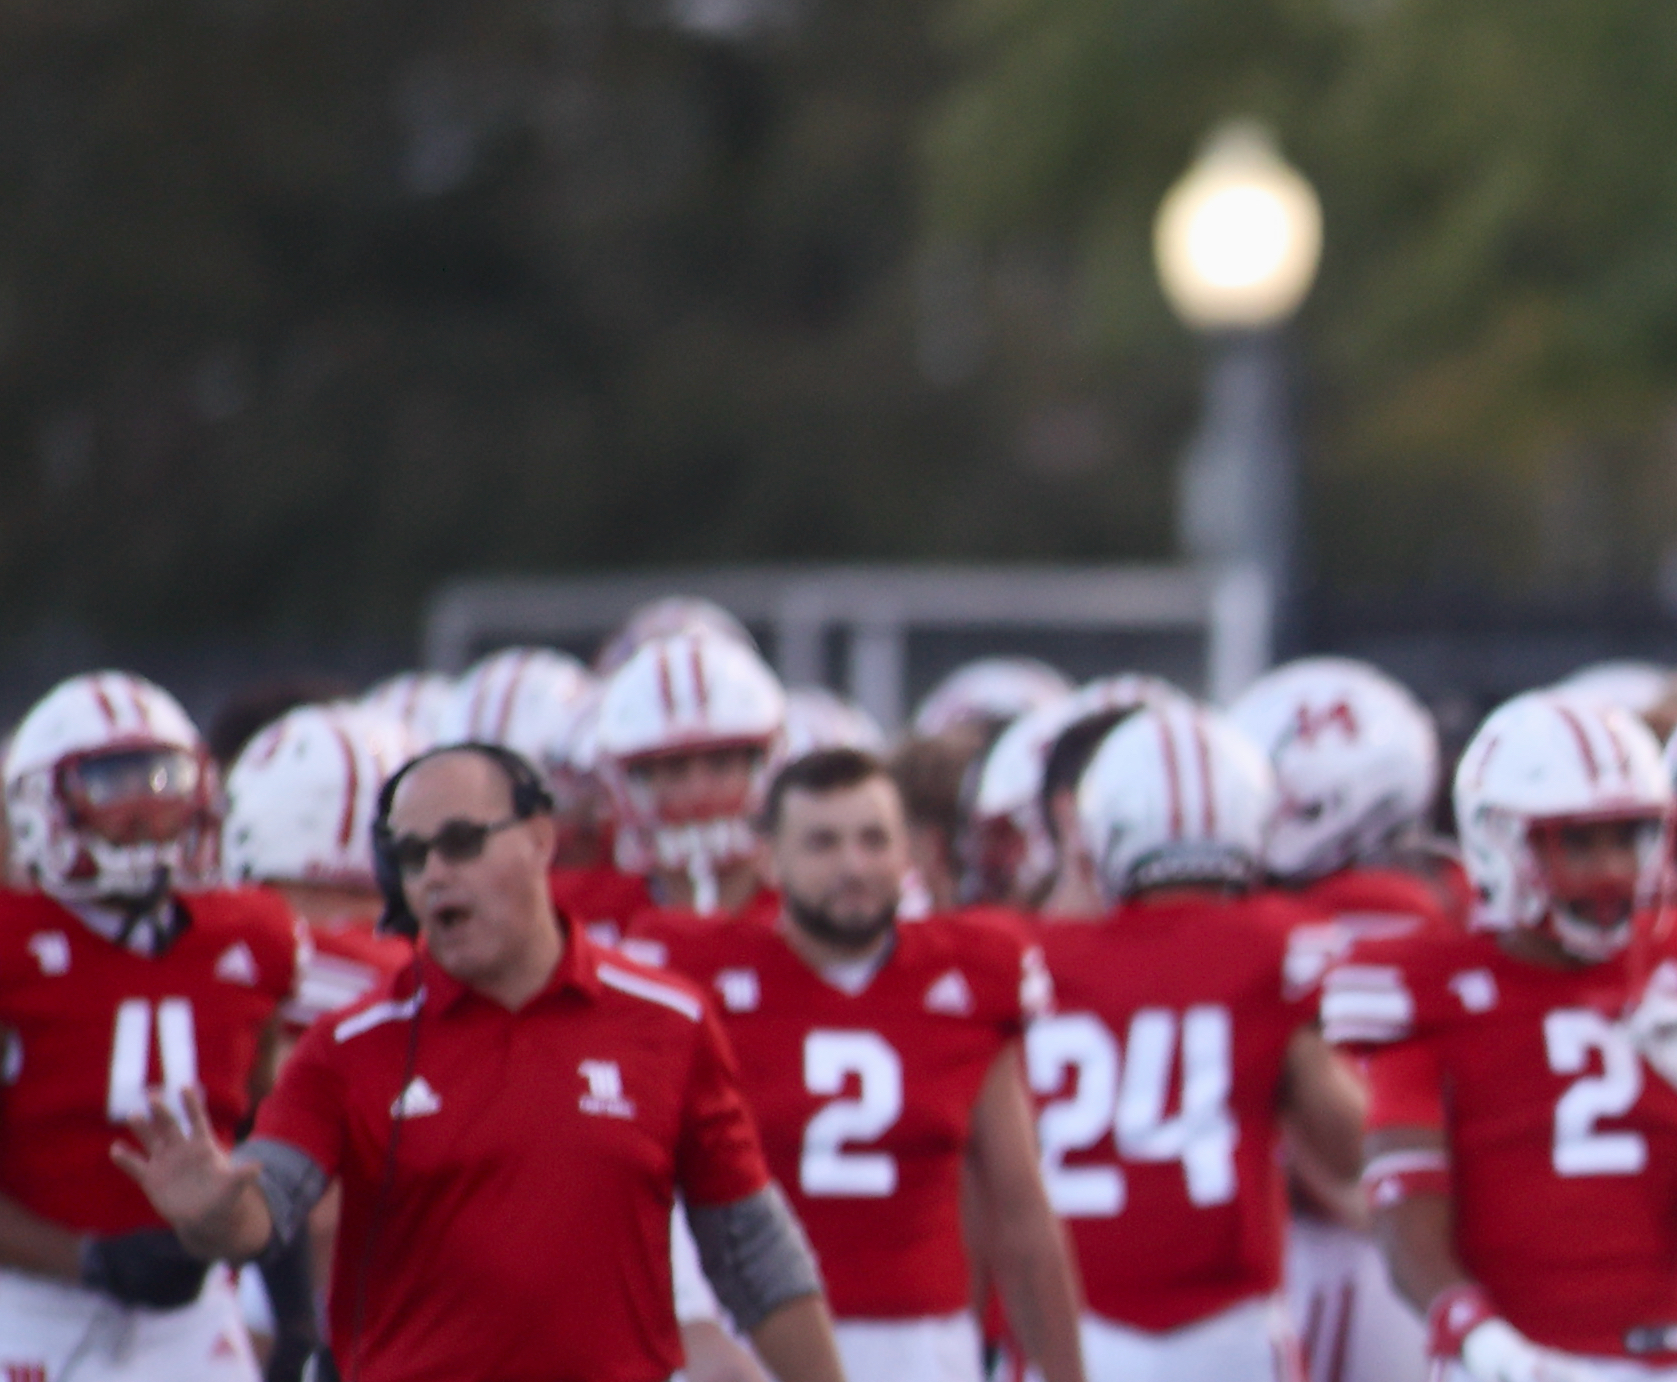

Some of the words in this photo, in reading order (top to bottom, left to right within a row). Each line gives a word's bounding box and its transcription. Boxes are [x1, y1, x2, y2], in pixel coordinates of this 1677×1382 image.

[800, 1029, 903, 1197] 2
[1025, 1005, 1238, 1218] 24
[1543, 1008, 1648, 1176] 2
